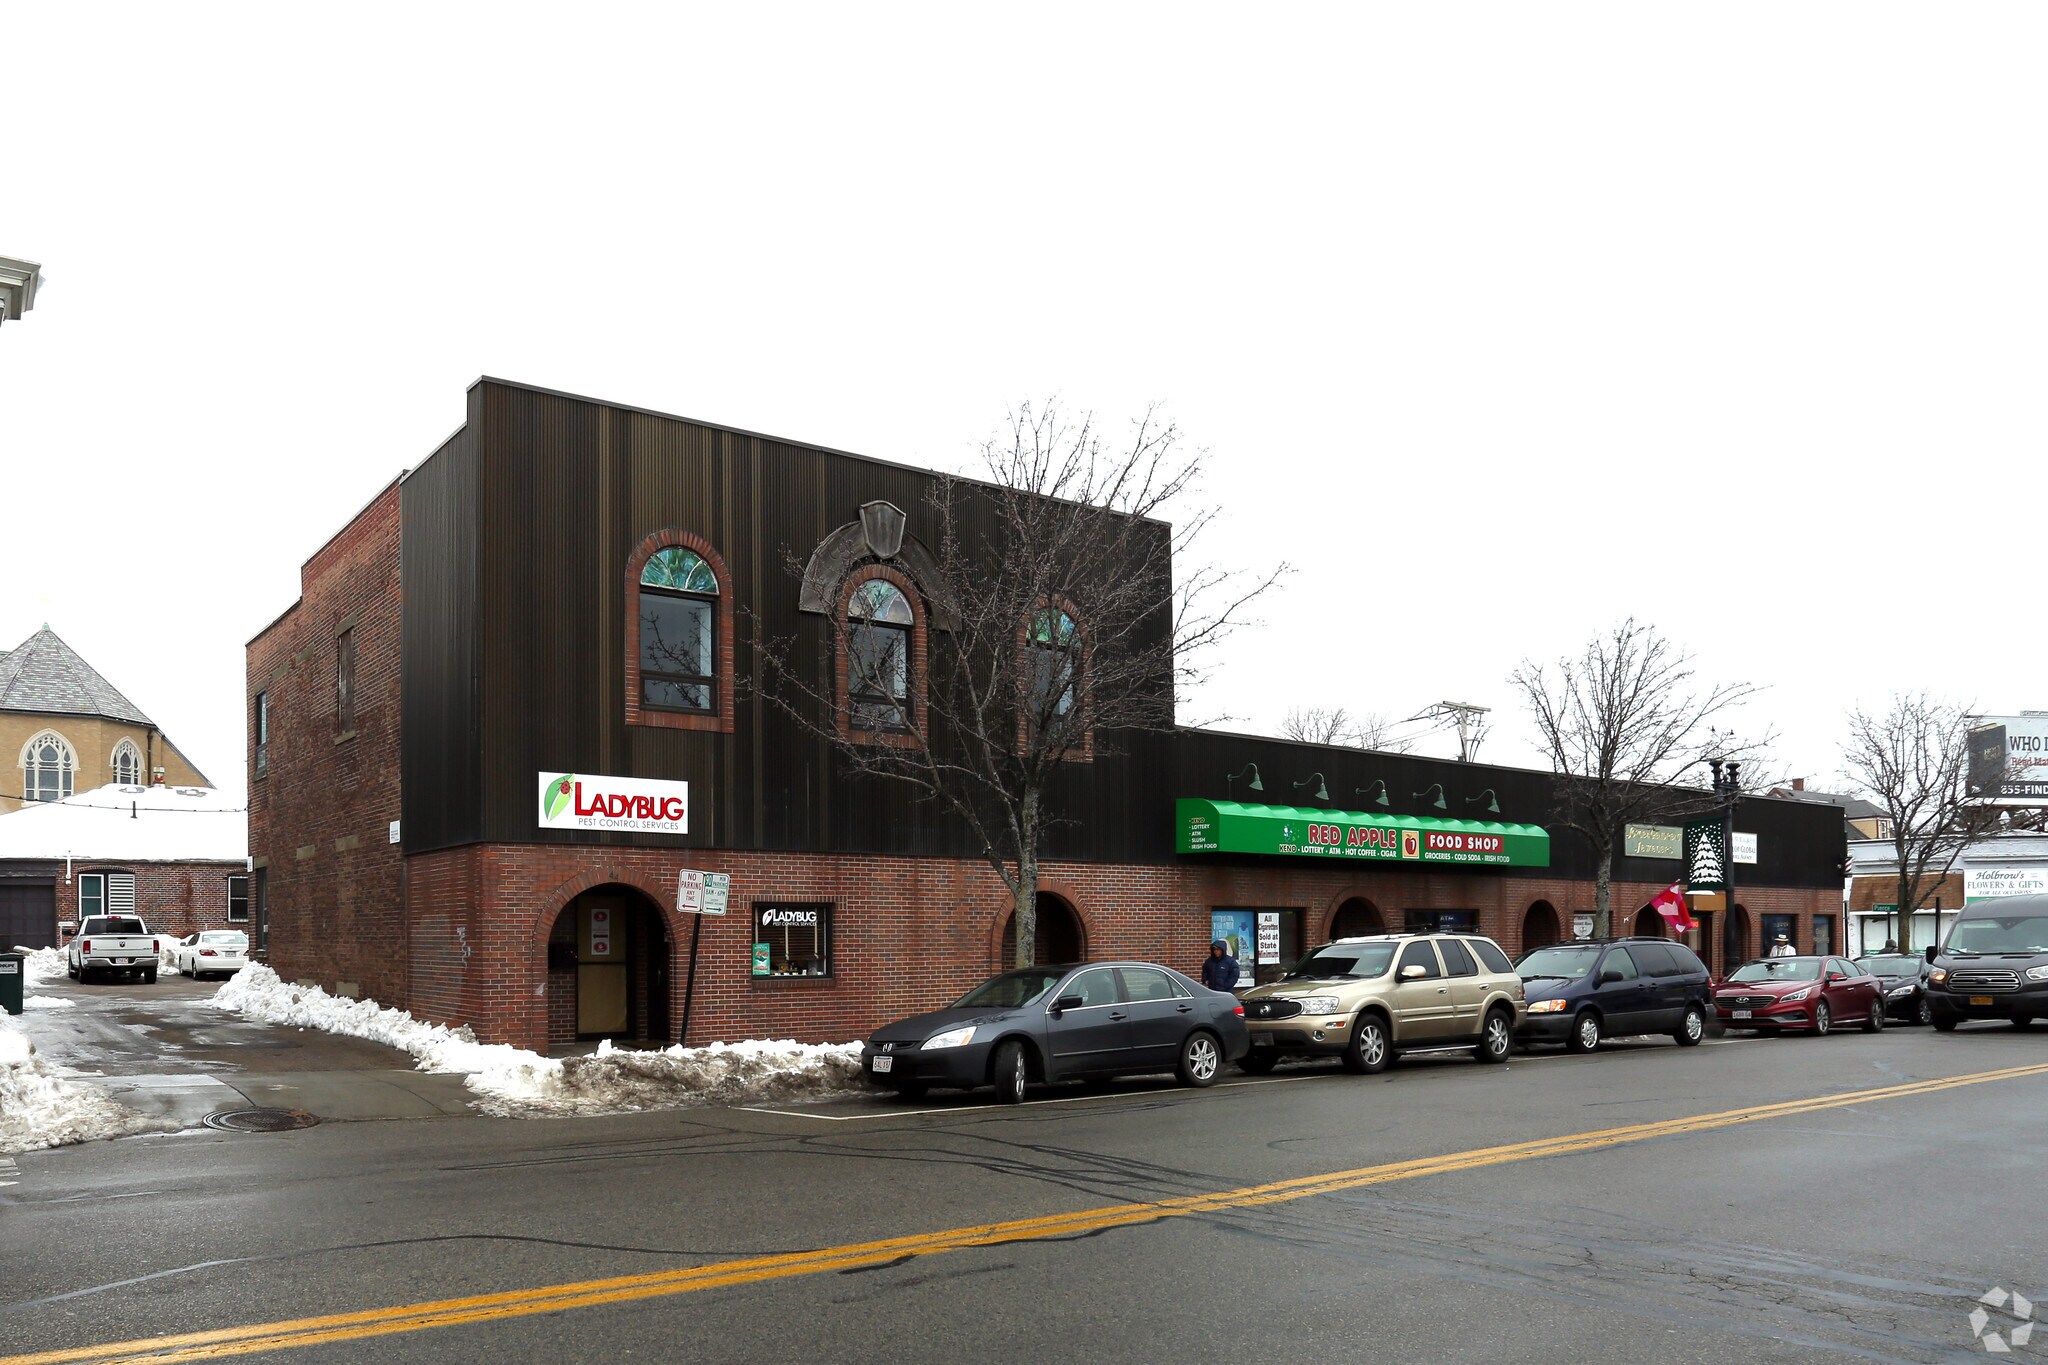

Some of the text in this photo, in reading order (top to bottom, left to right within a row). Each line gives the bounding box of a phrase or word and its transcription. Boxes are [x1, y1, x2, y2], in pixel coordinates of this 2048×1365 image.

[2010, 736, 2040, 751] WHO
[574, 782, 684, 820] LADYBUG
[578, 818, 678, 830] PEST CONTROL SERVICES
[1308, 824, 1397, 848] RED APPLE
[1430, 834, 1498, 850] FOOD SHOP
[1279, 844, 1297, 853] KENO
[1301, 845, 1325, 854] LOTTERY
[1976, 870, 2024, 880] Holbrow's
[681, 881, 701, 890] PARKING
[773, 909, 817, 922] LADYBUG
